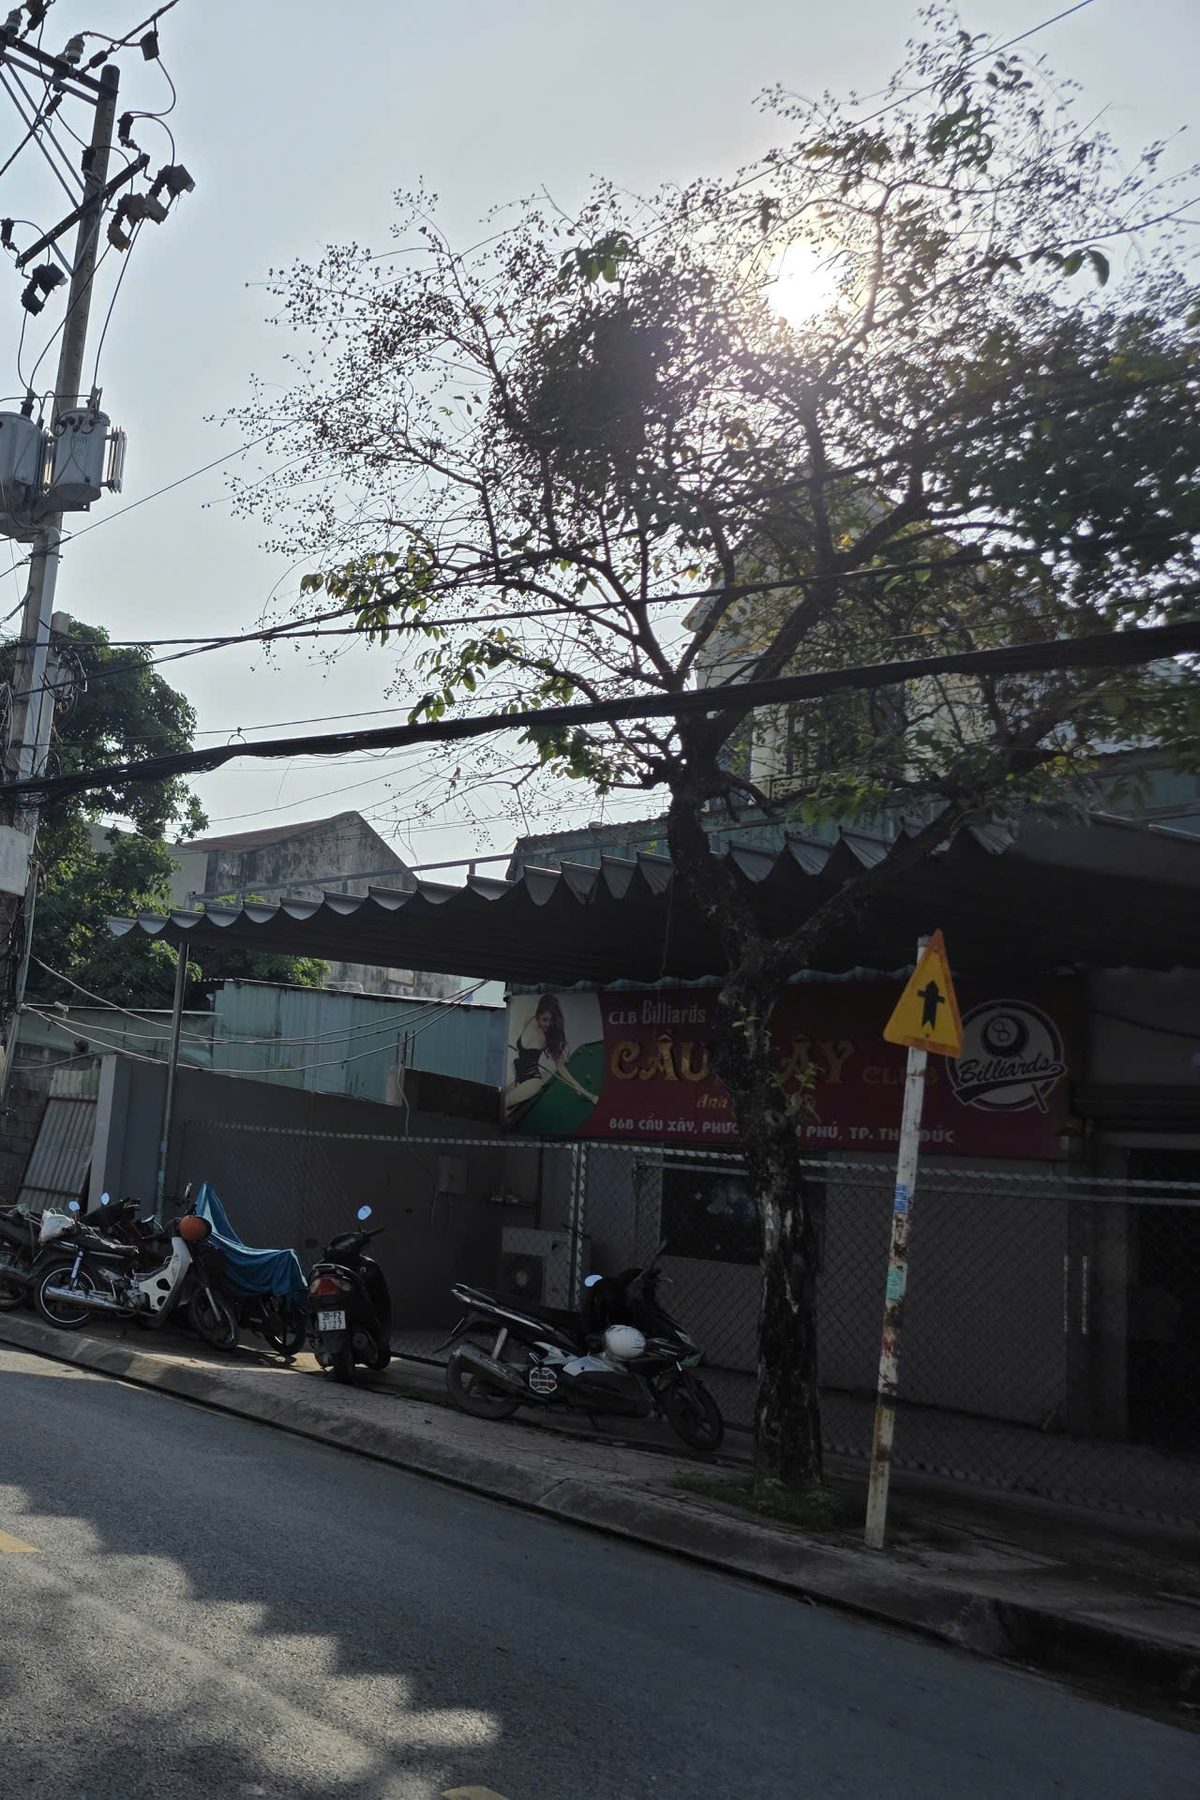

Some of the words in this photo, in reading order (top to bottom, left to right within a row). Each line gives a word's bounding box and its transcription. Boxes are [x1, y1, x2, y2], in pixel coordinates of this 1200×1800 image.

[608, 1010, 637, 1025] CLB
[641, 999, 706, 1025] Billiards
[862, 1066, 939, 1087] CLB
[959, 1051, 1050, 1084] Billiards
[608, 1118, 634, 1131] 86B
